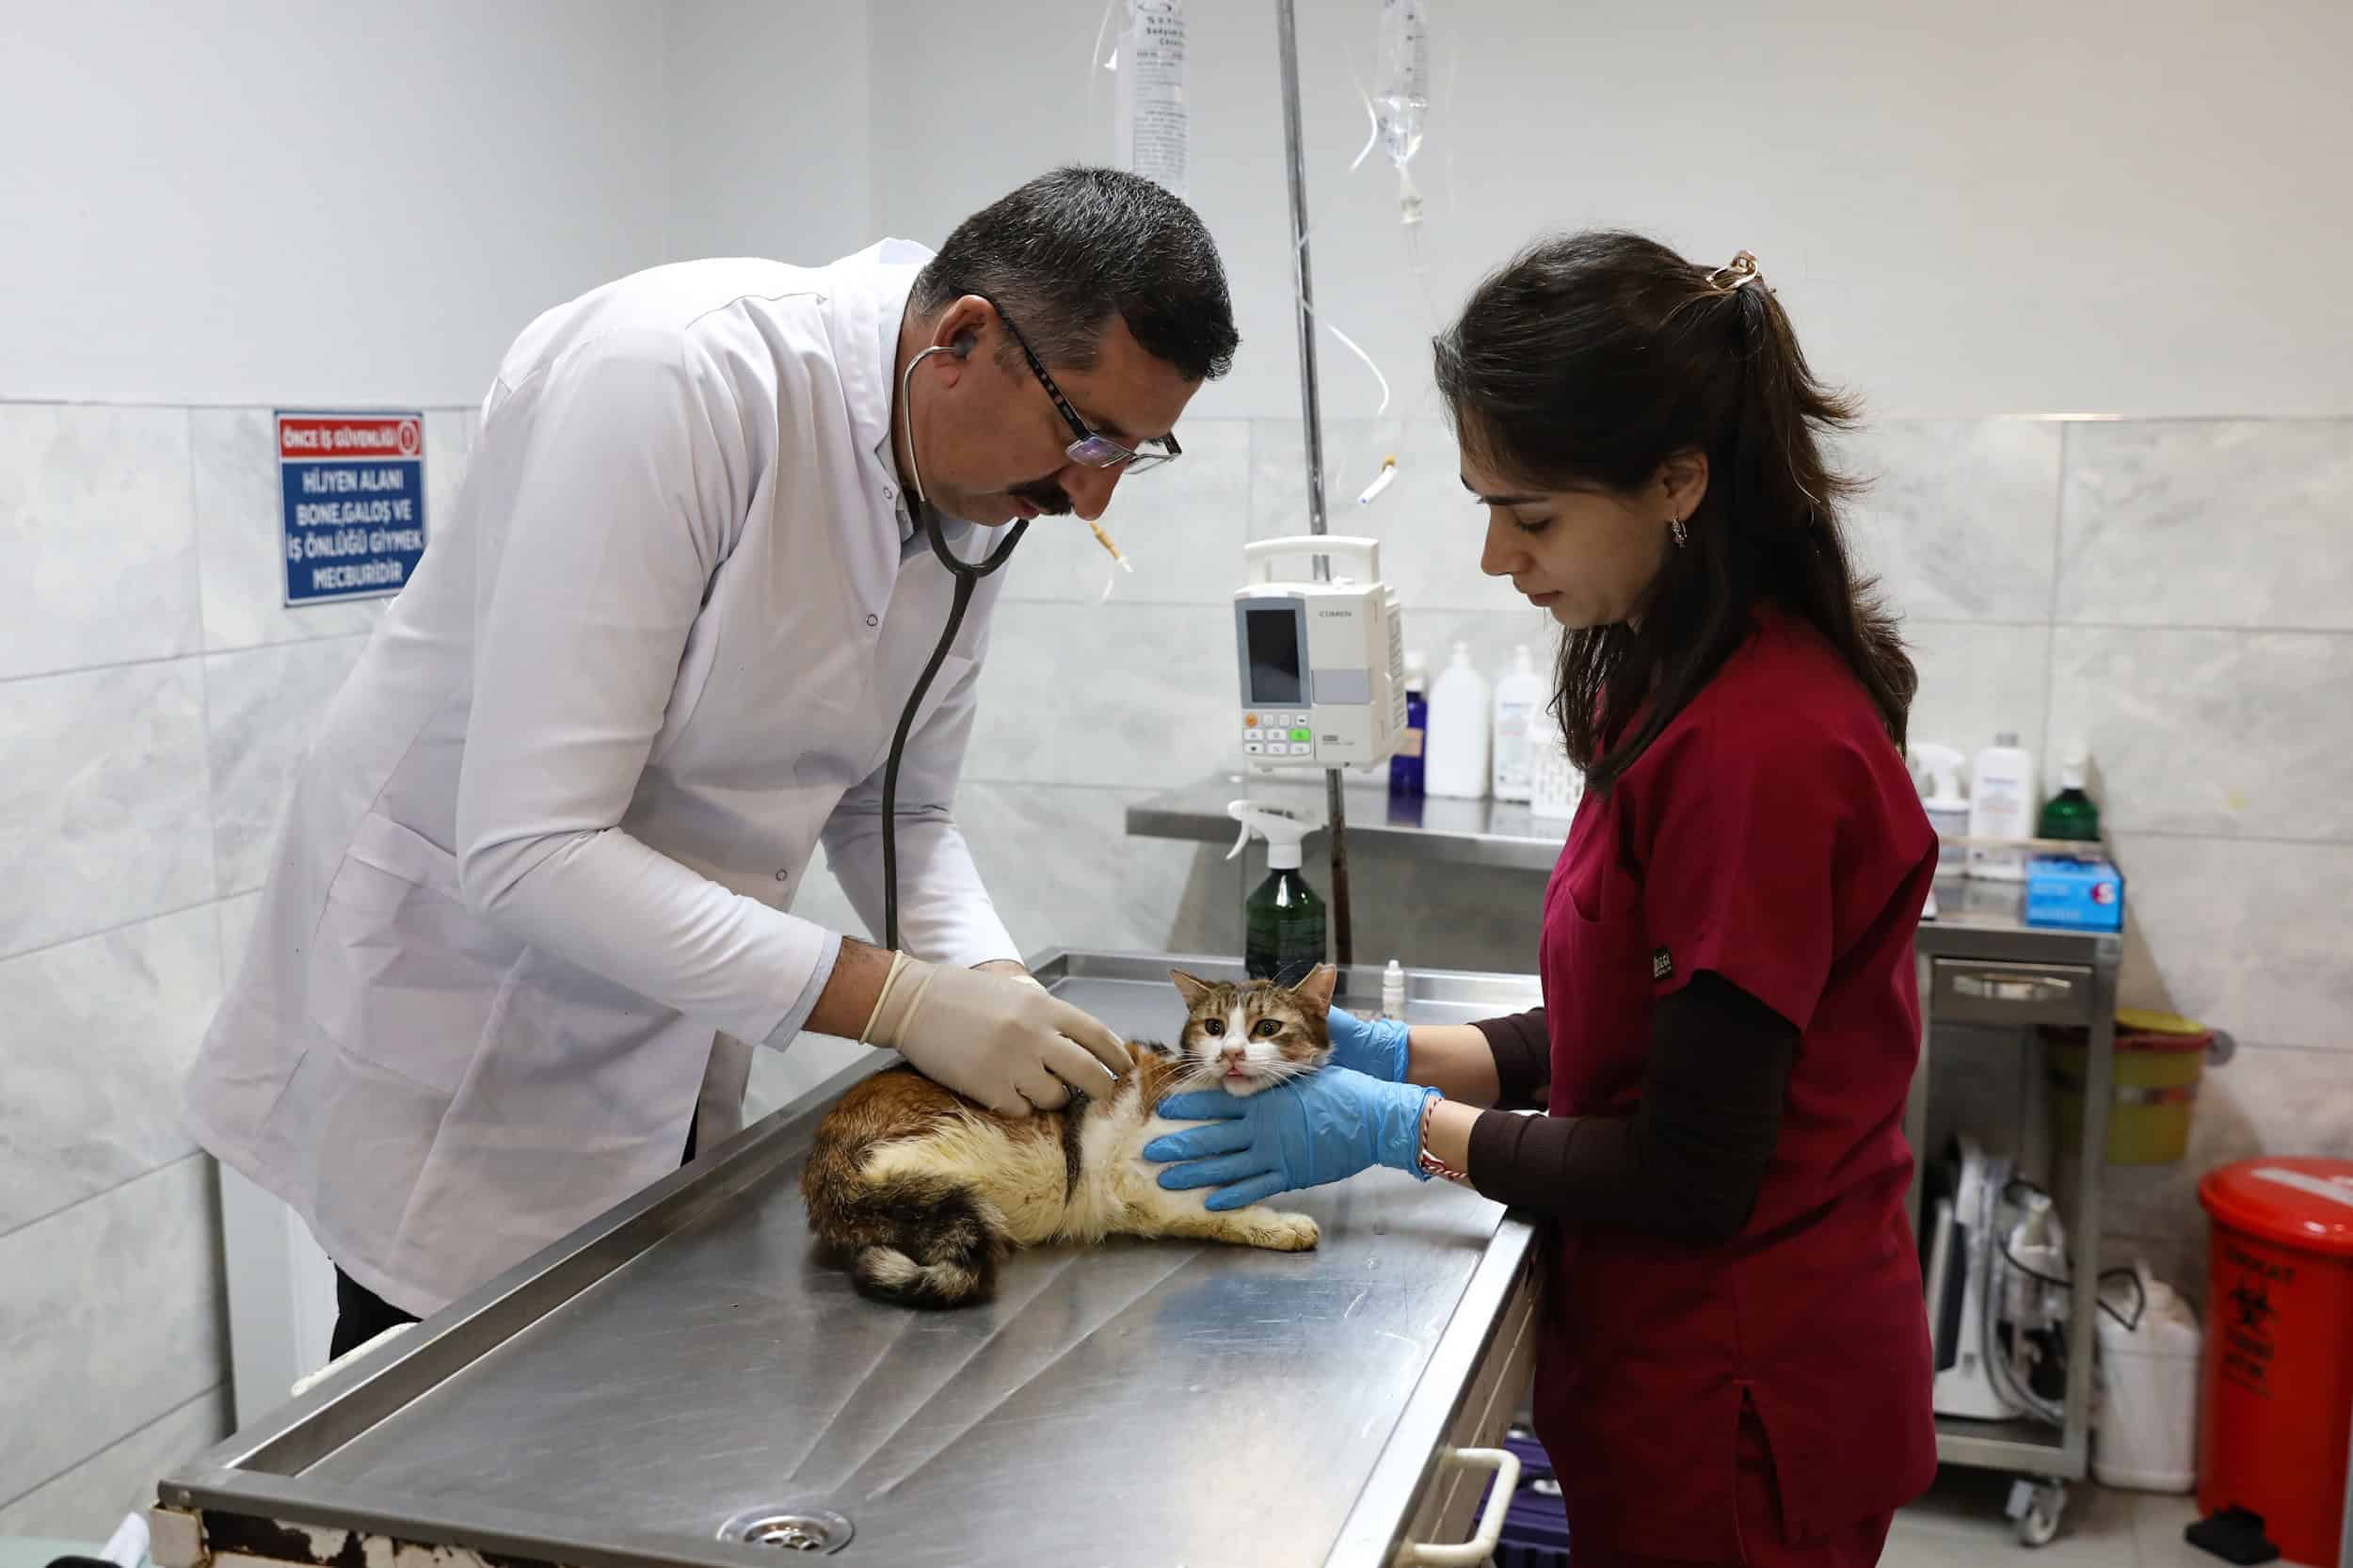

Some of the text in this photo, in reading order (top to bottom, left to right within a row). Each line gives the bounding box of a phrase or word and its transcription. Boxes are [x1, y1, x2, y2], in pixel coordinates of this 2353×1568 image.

[284, 425, 317, 449] ÖNCE
[321, 424, 332, 451] İŞ
[302, 467, 404, 493] HİJYEN ALANI
[392, 499, 412, 520] VE
[286, 527, 423, 562] İŞ ÖNLÜĞÜ GİYMEK
[312, 559, 403, 590] MECBURİDİR
